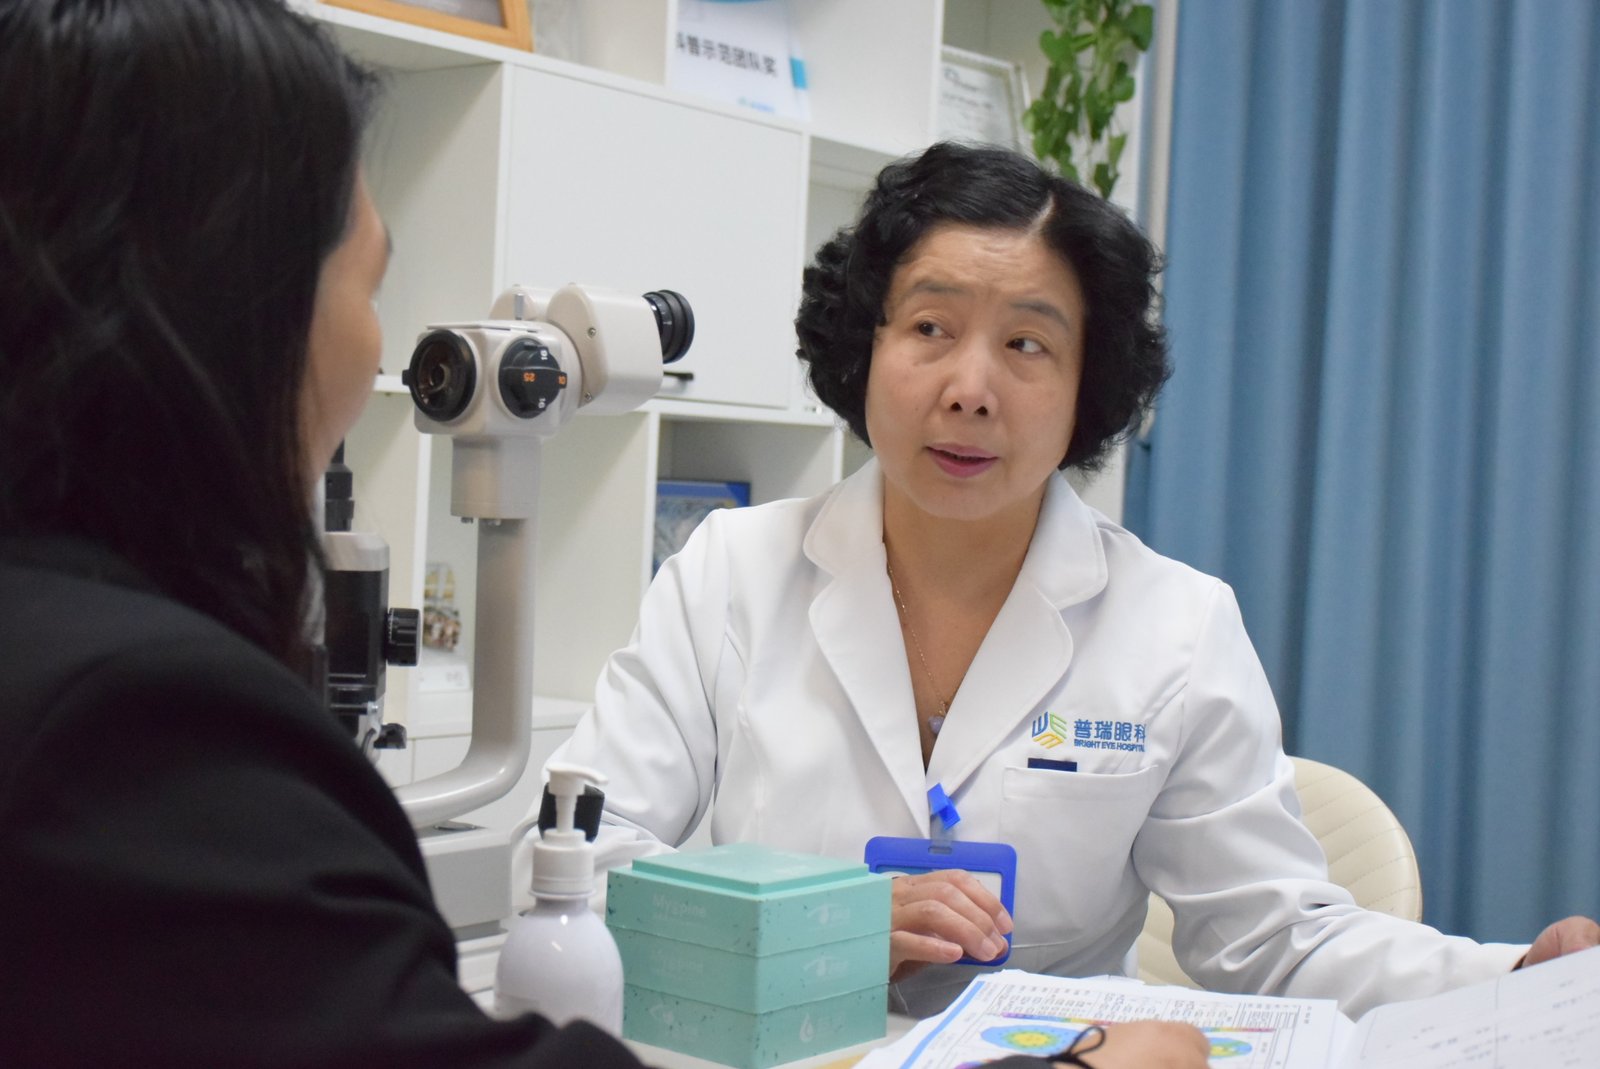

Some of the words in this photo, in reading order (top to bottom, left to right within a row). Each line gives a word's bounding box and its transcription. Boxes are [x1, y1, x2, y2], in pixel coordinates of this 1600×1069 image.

[1074, 719, 1147, 743] 普瑞眼科
[1074, 738, 1100, 749] BRIGHT
[1101, 742, 1116, 750] EYE
